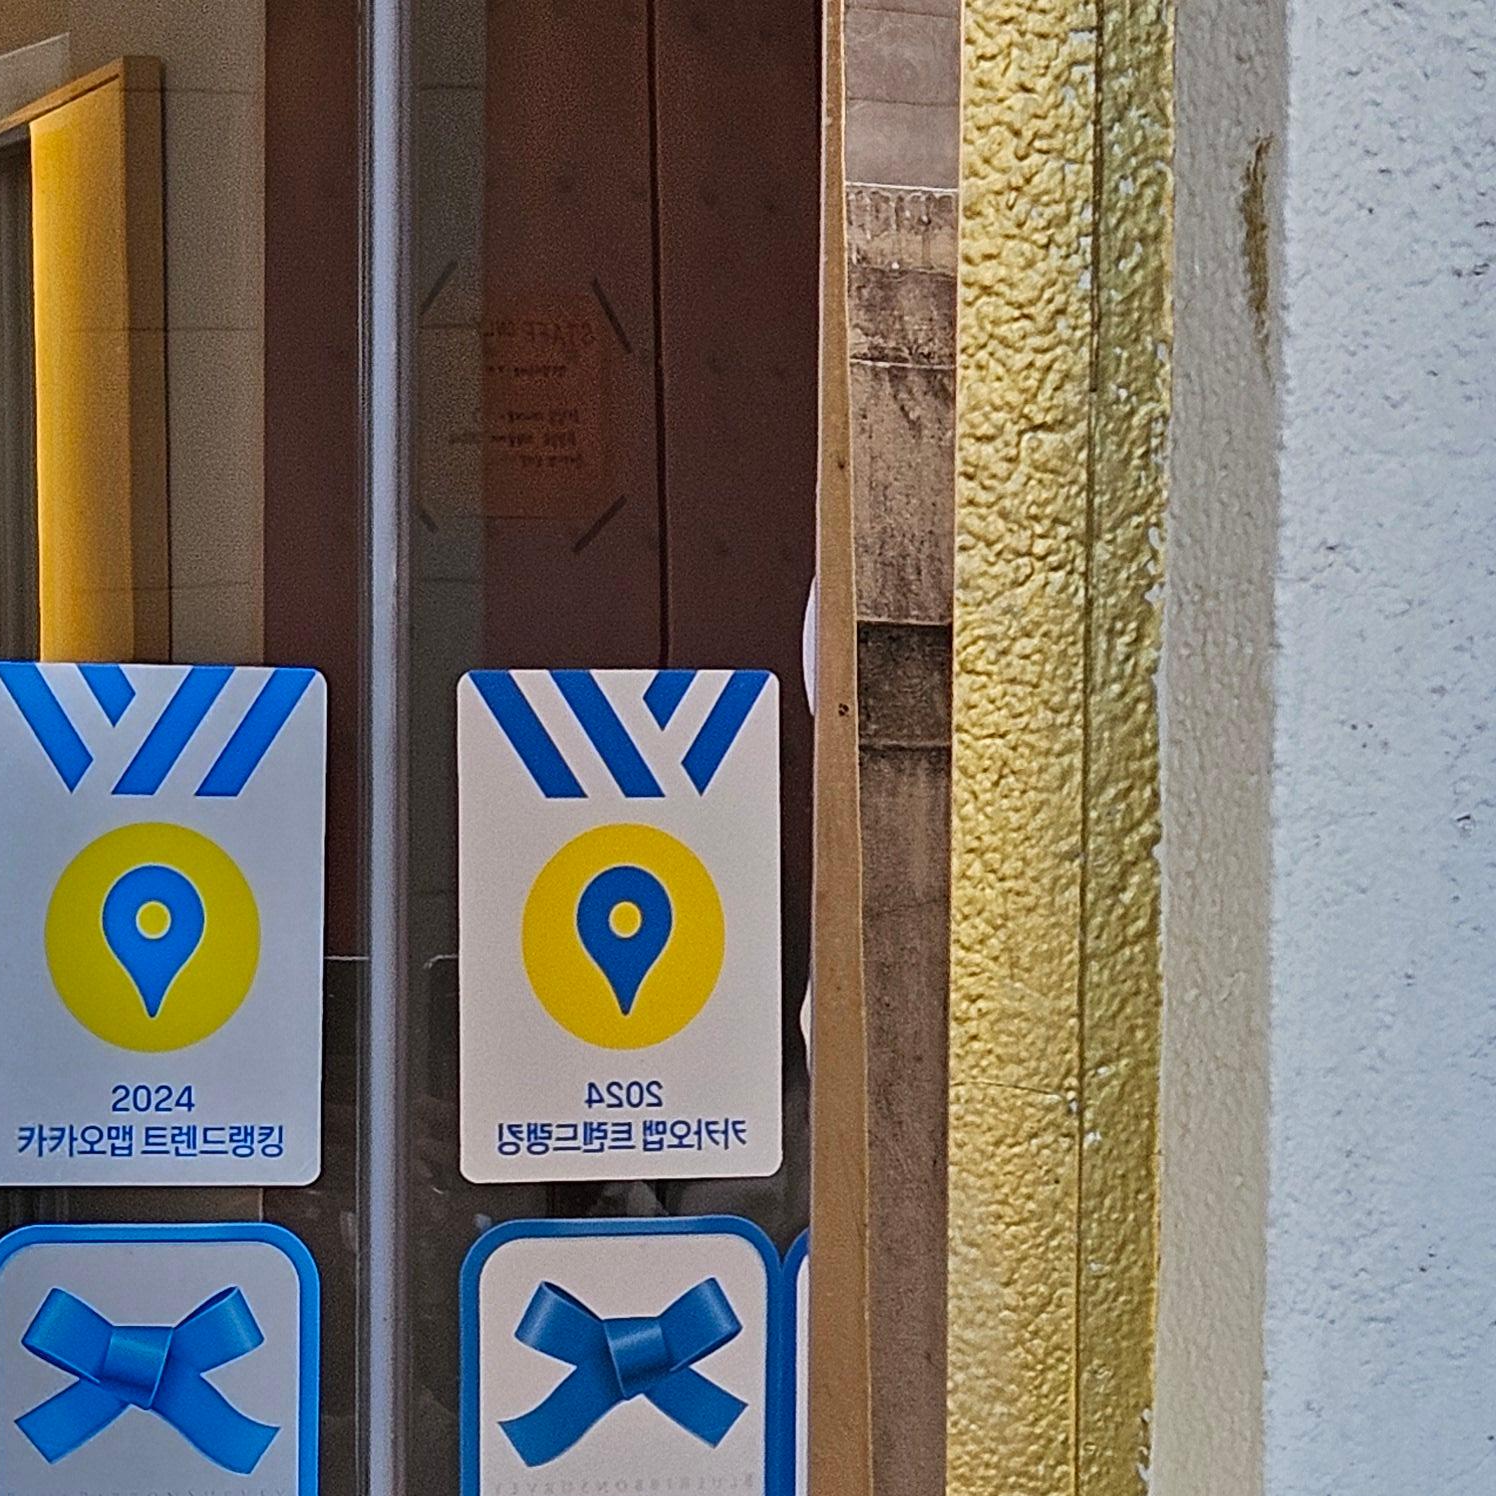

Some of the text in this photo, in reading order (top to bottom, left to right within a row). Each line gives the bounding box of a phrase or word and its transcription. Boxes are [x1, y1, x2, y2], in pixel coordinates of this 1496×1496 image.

[111, 1084, 196, 1113] 2024
[16, 1123, 285, 1160] 카카오맵 트렌드랭킹
